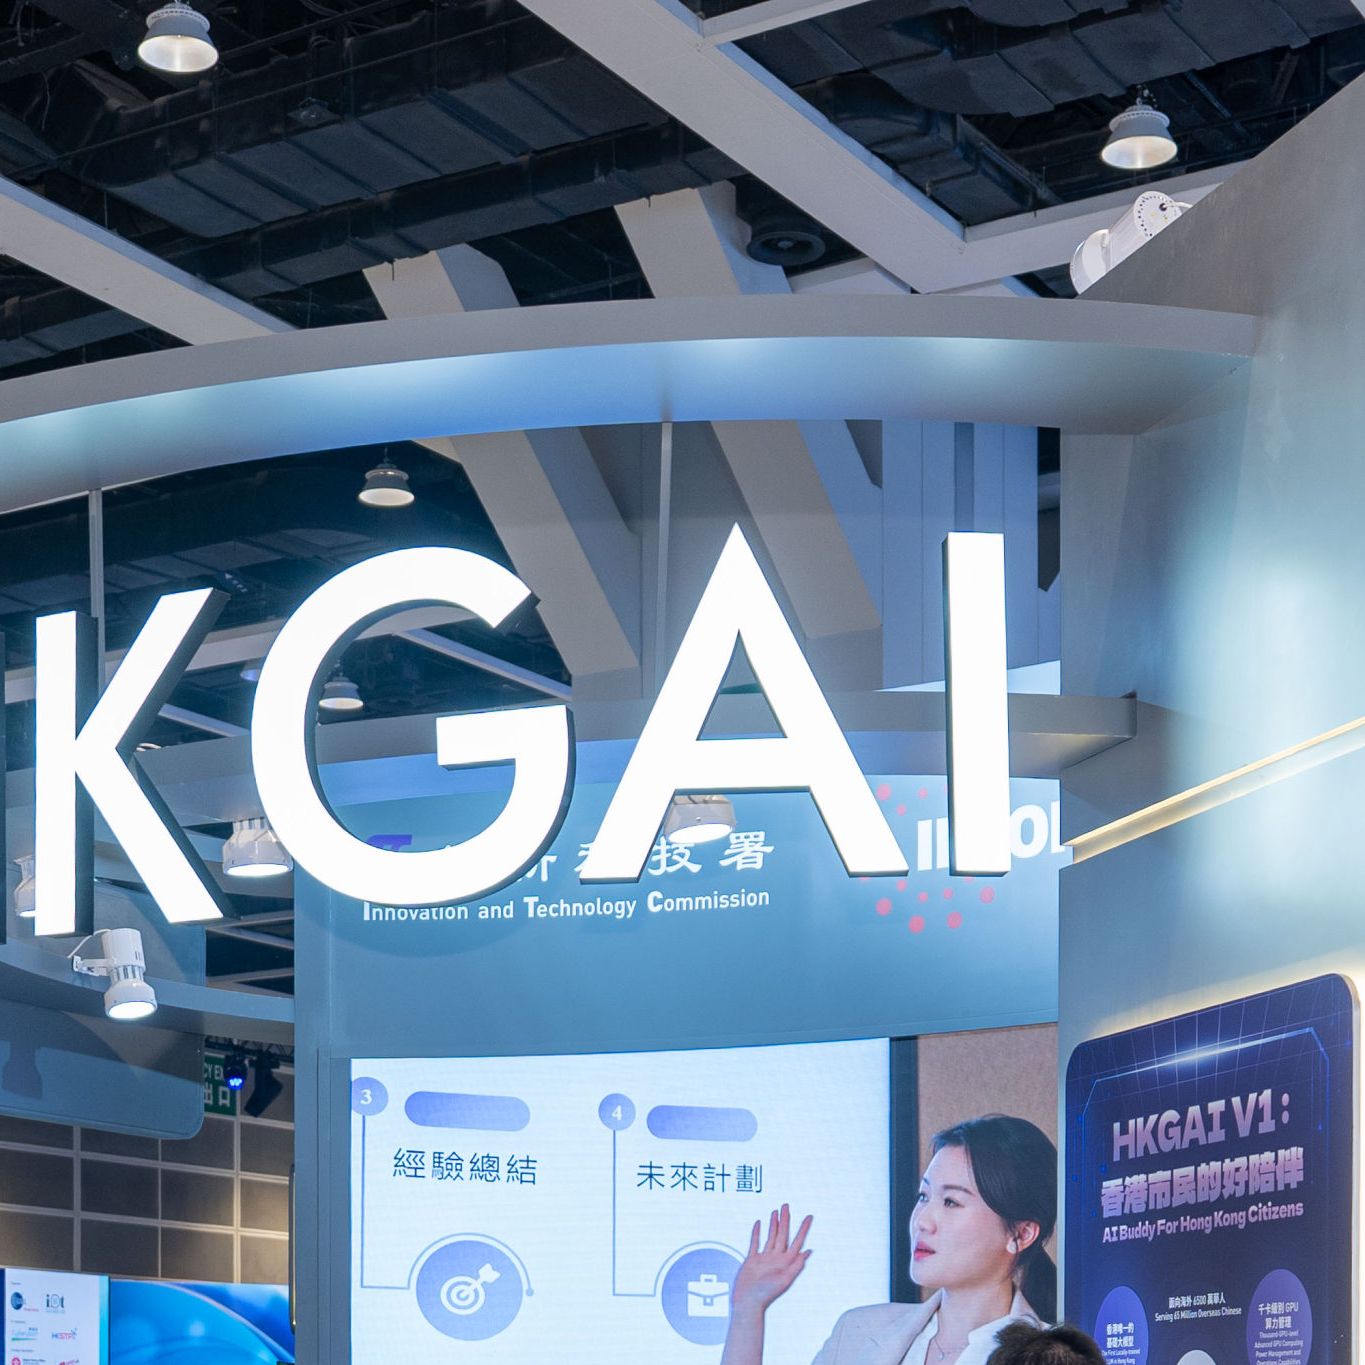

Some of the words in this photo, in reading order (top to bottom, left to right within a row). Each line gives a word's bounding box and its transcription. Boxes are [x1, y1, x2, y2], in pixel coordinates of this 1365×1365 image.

[363, 902, 469, 921] Innovation
[478, 900, 514, 920] and
[523, 895, 637, 920] Technology
[647, 889, 770, 913] Commission
[360, 1088, 373, 1104] 3
[611, 1106, 623, 1121] 4
[1113, 1099, 1226, 1162] HKGAI
[392, 1149, 538, 1186] 經驗總結
[636, 1161, 764, 1194] 未來計劃
[1101, 1146, 1304, 1218] 香港市民的好陪伴
[1102, 1226, 1119, 1243] AI
[1119, 1221, 1155, 1242] Buddy
[1157, 1218, 1179, 1236] For
[1180, 1215, 1212, 1234] Hong
[1214, 1208, 1246, 1229] Kong
[1248, 1201, 1304, 1223] Citizens
[1197, 1308, 1221, 1318] Overseas
[1222, 1307, 1242, 1316] Chinese
